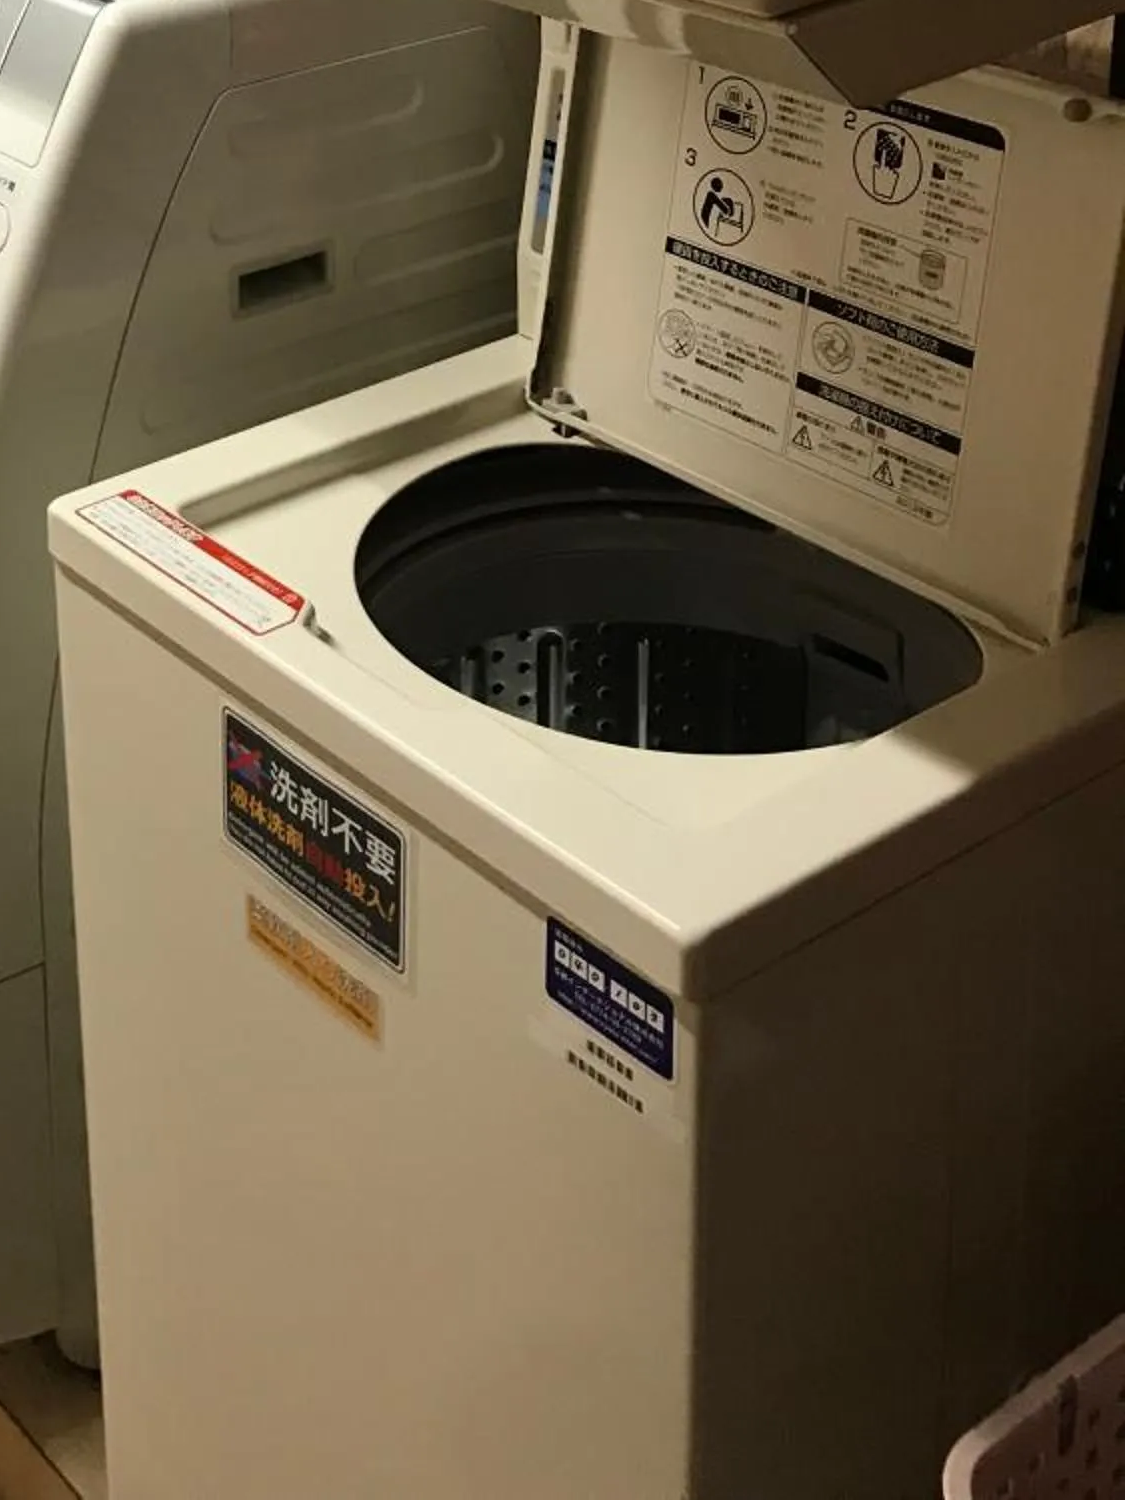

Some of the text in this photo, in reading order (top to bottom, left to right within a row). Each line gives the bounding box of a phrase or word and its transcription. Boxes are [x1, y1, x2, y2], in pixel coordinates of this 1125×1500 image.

[844, 110, 857, 130] 2
[684, 148, 698, 167] 3
[269, 760, 396, 886] 洗剤不要
